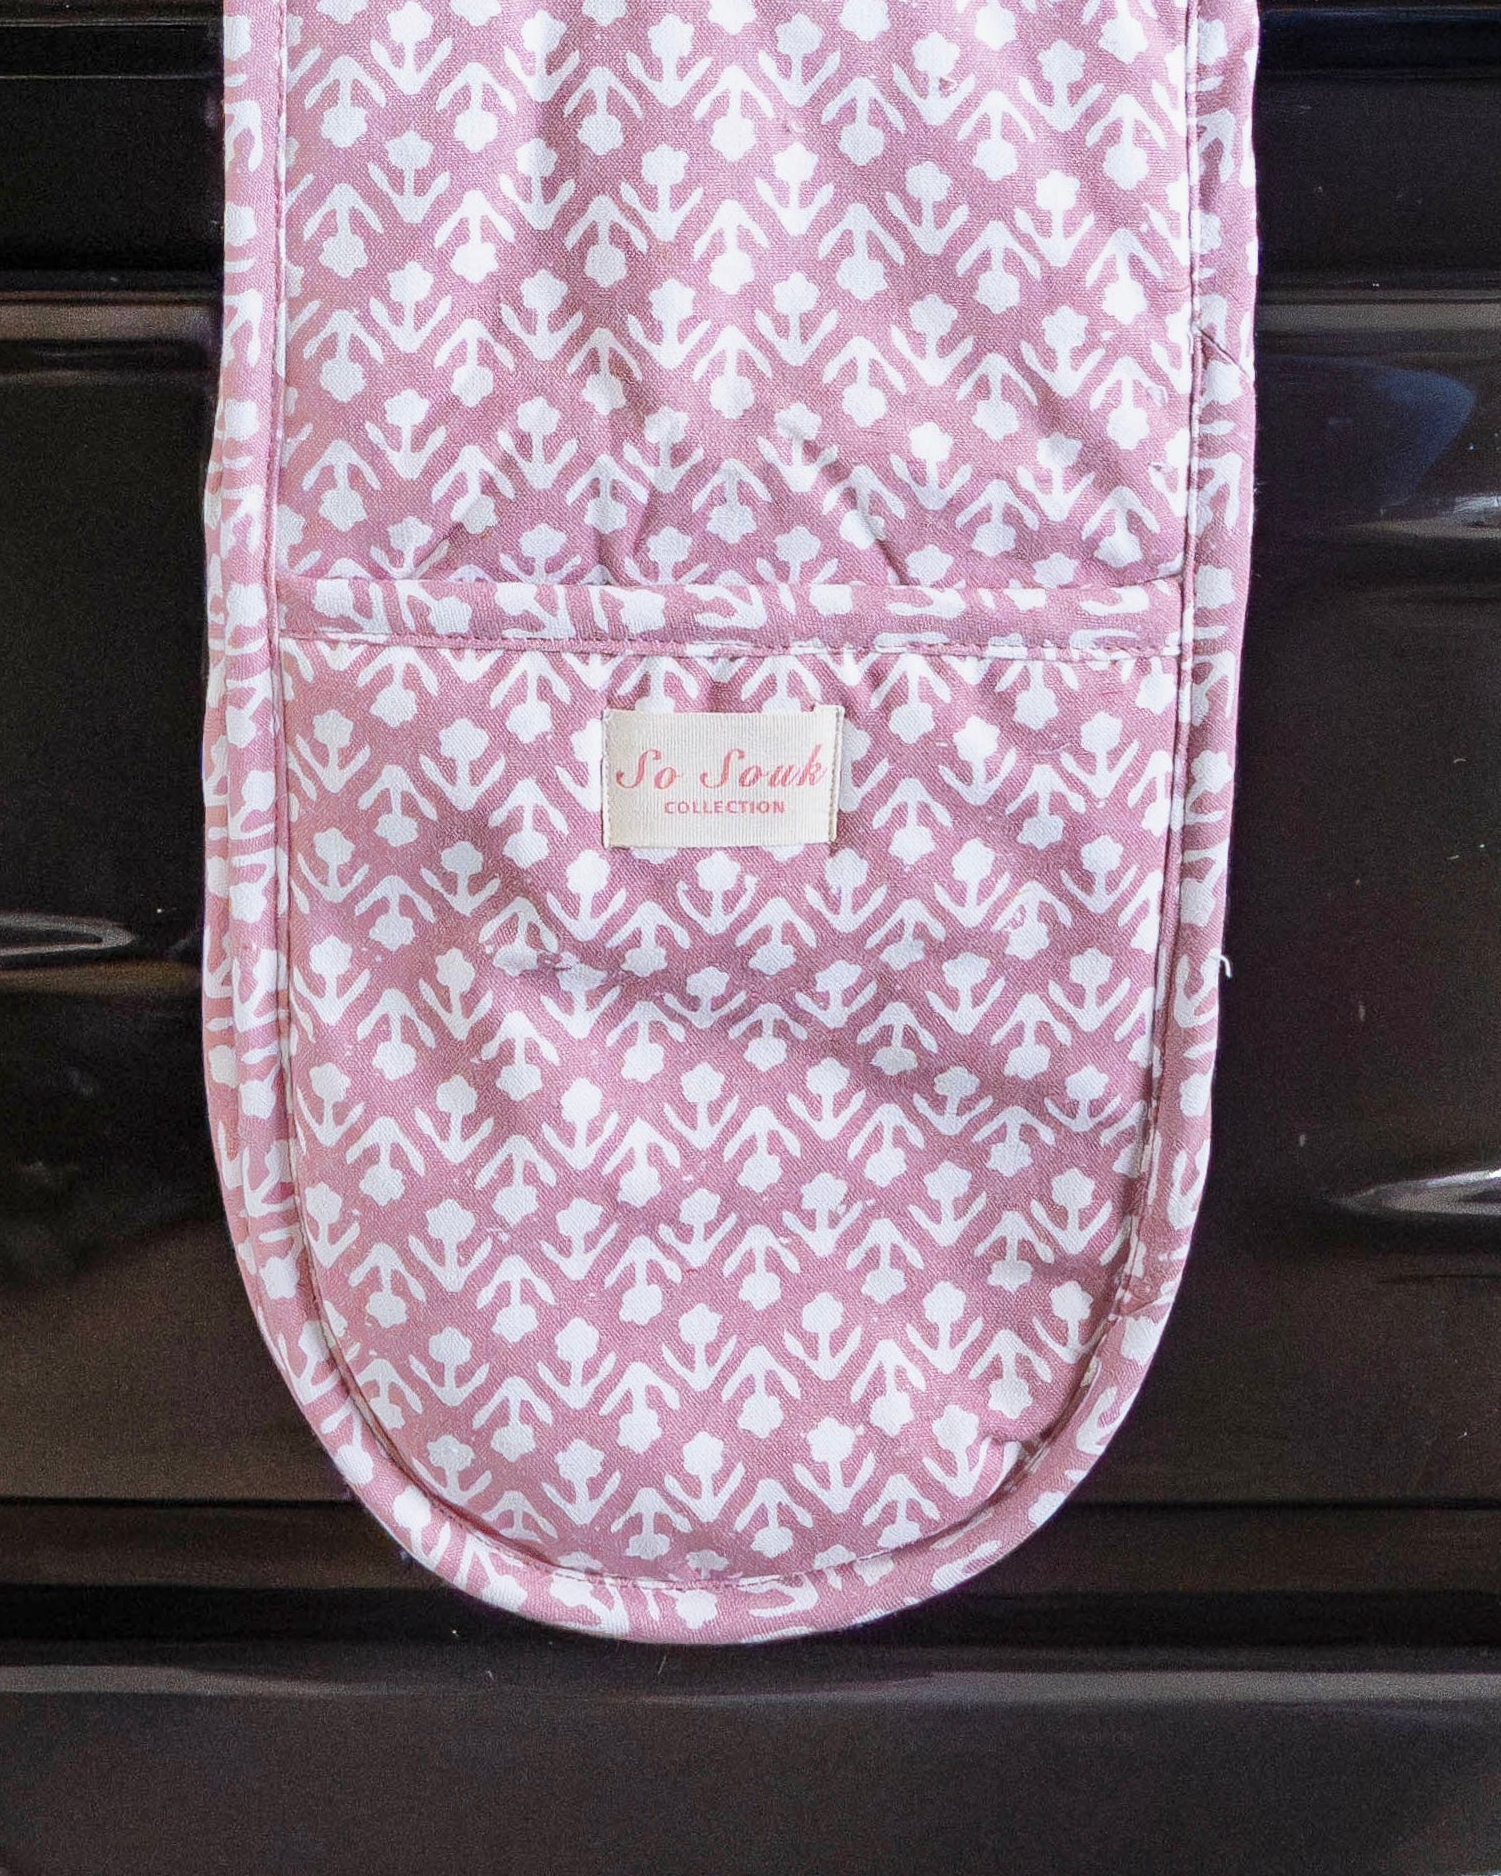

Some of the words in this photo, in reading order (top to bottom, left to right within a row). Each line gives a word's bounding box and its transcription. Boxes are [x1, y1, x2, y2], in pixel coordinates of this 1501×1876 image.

[615, 748, 679, 790] So
[699, 744, 826, 789] Souk
[664, 800, 786, 815] COLLECTION
